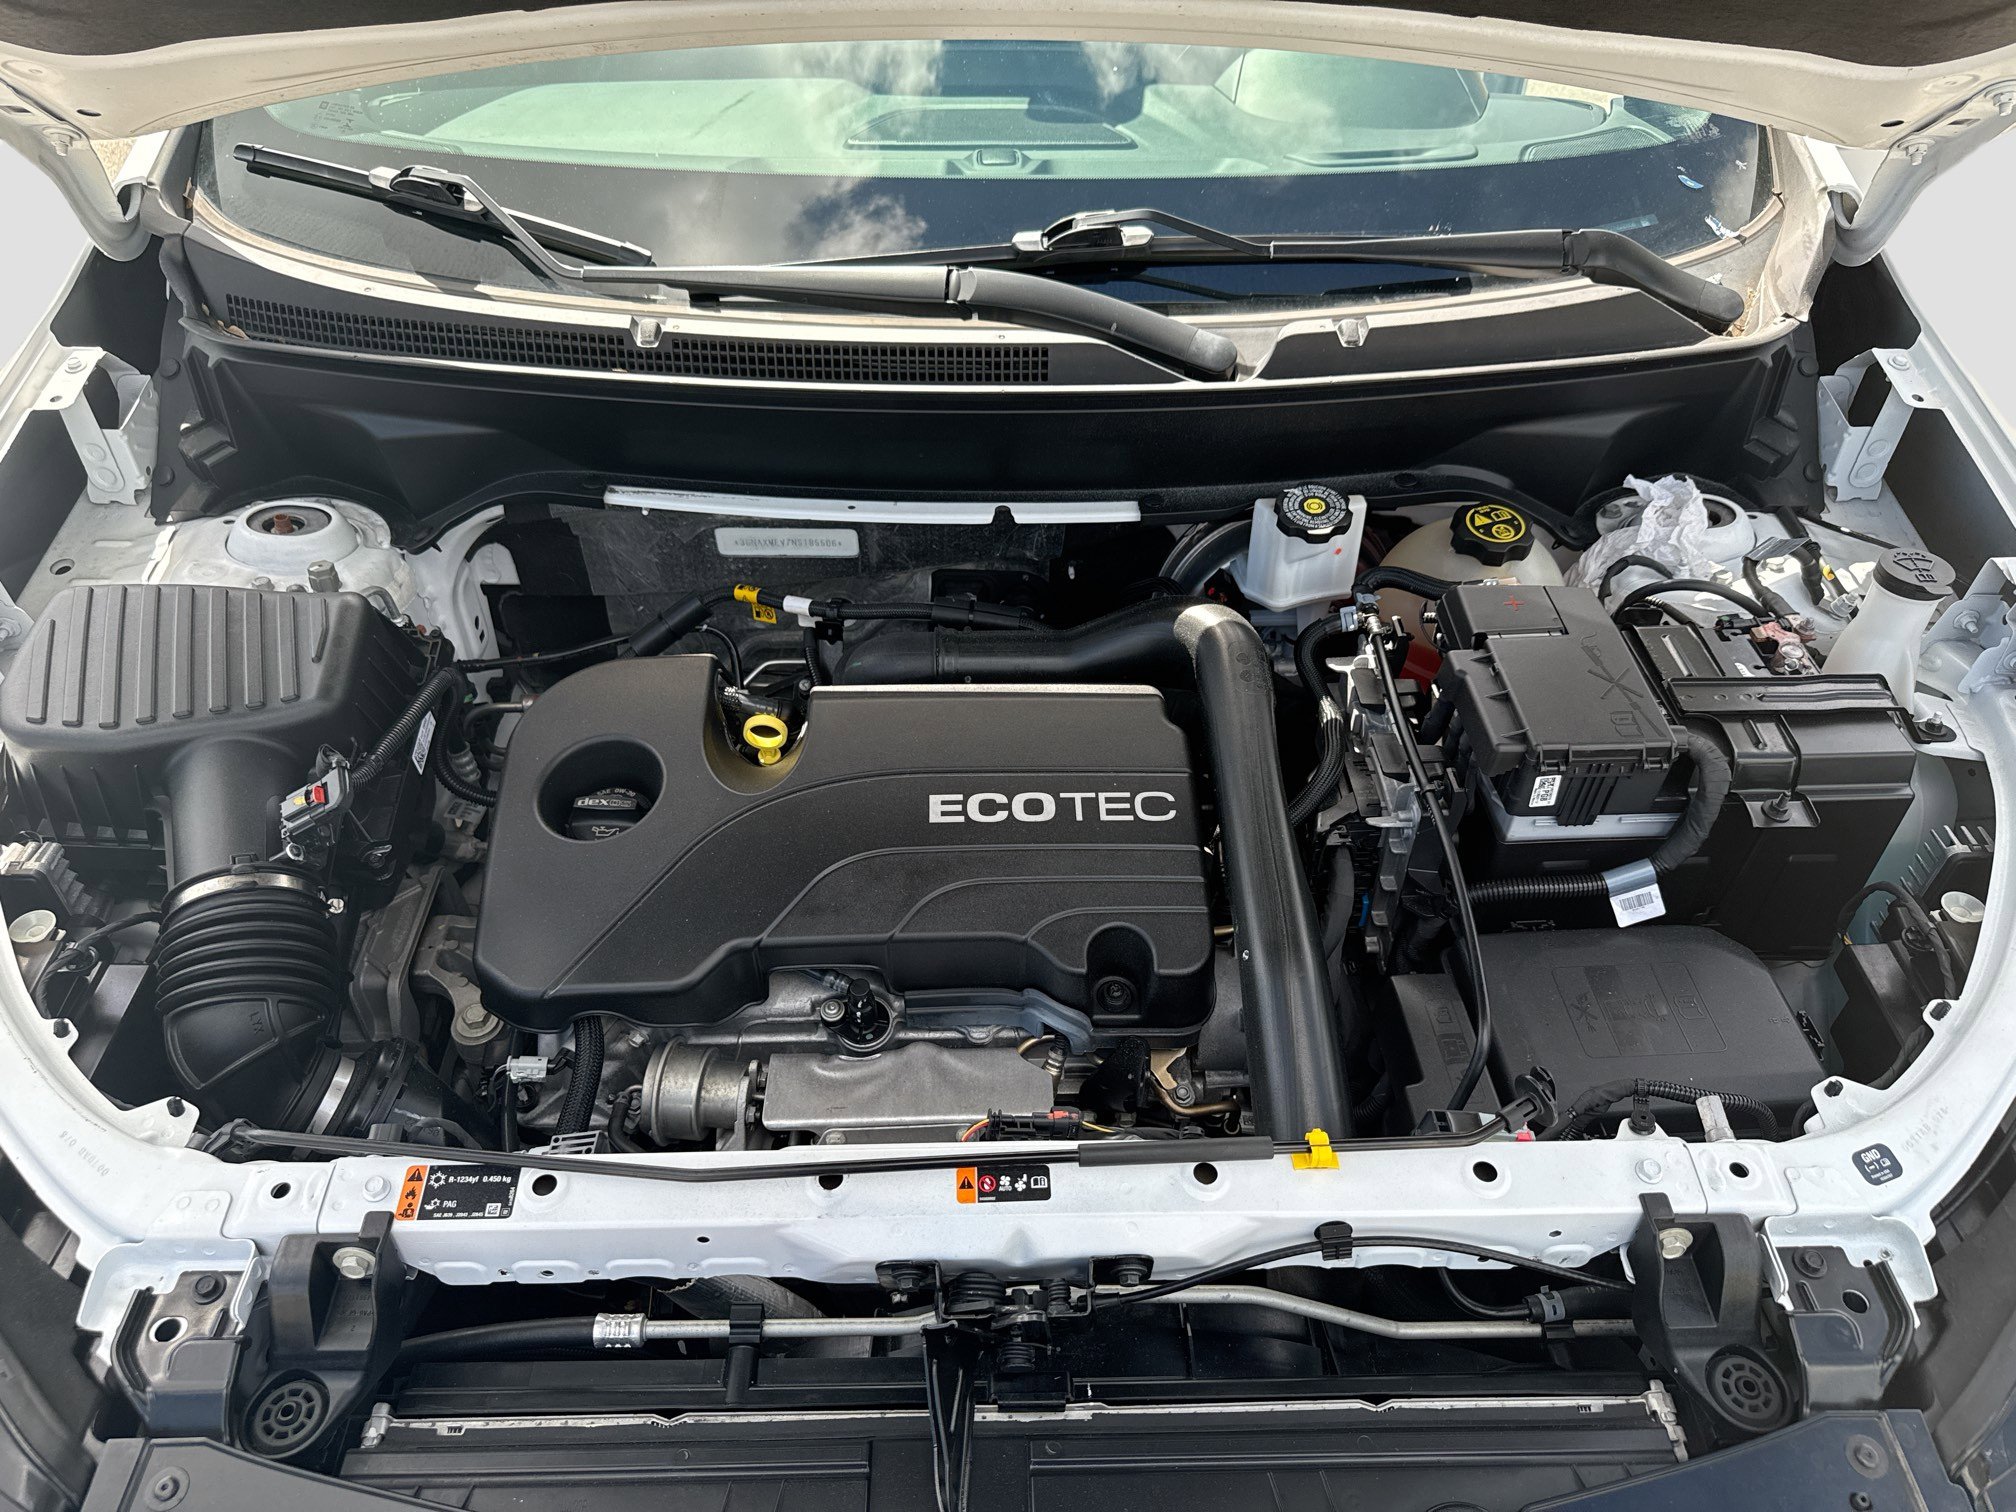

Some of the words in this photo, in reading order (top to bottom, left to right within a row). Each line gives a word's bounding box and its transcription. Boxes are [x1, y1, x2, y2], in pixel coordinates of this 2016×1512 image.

[577, 797, 632, 807] dexos
[928, 791, 1177, 823] ECOTEC
[1860, 1149, 1881, 1163] GND
[448, 1175, 480, 1184] R-1234yf
[482, 1175, 502, 1183] 0.450
[502, 1175, 512, 1183] kg
[442, 1200, 457, 1208] PAG
